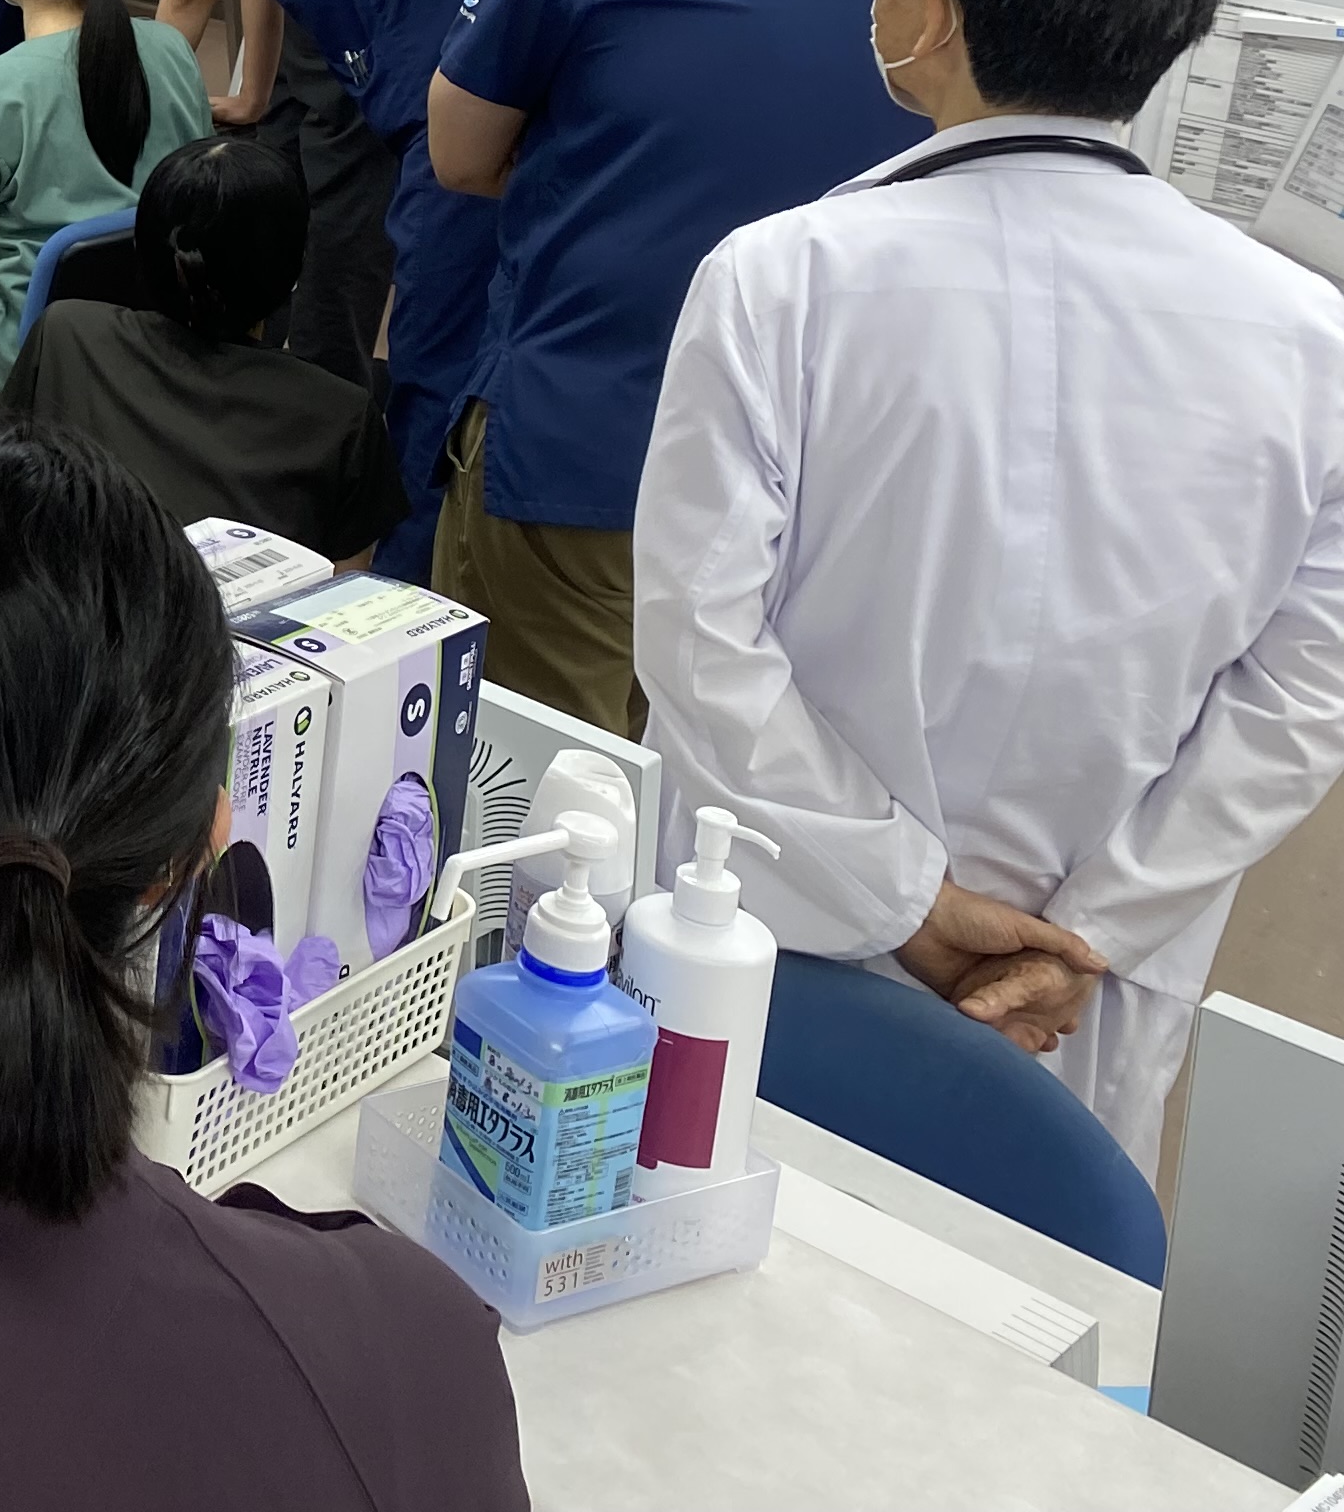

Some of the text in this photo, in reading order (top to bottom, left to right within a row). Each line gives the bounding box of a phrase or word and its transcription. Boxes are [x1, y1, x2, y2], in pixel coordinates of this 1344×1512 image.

[407, 615, 454, 638] HALYARD
[303, 639, 320, 651] S
[243, 677, 295, 703] HALYARD
[407, 697, 426, 722] S
[247, 725, 263, 798] NITRILE
[256, 720, 275, 817] LAVENDER
[287, 740, 306, 850] HALYARD
[545, 1249, 583, 1274] with
[544, 1271, 579, 1297] 531
